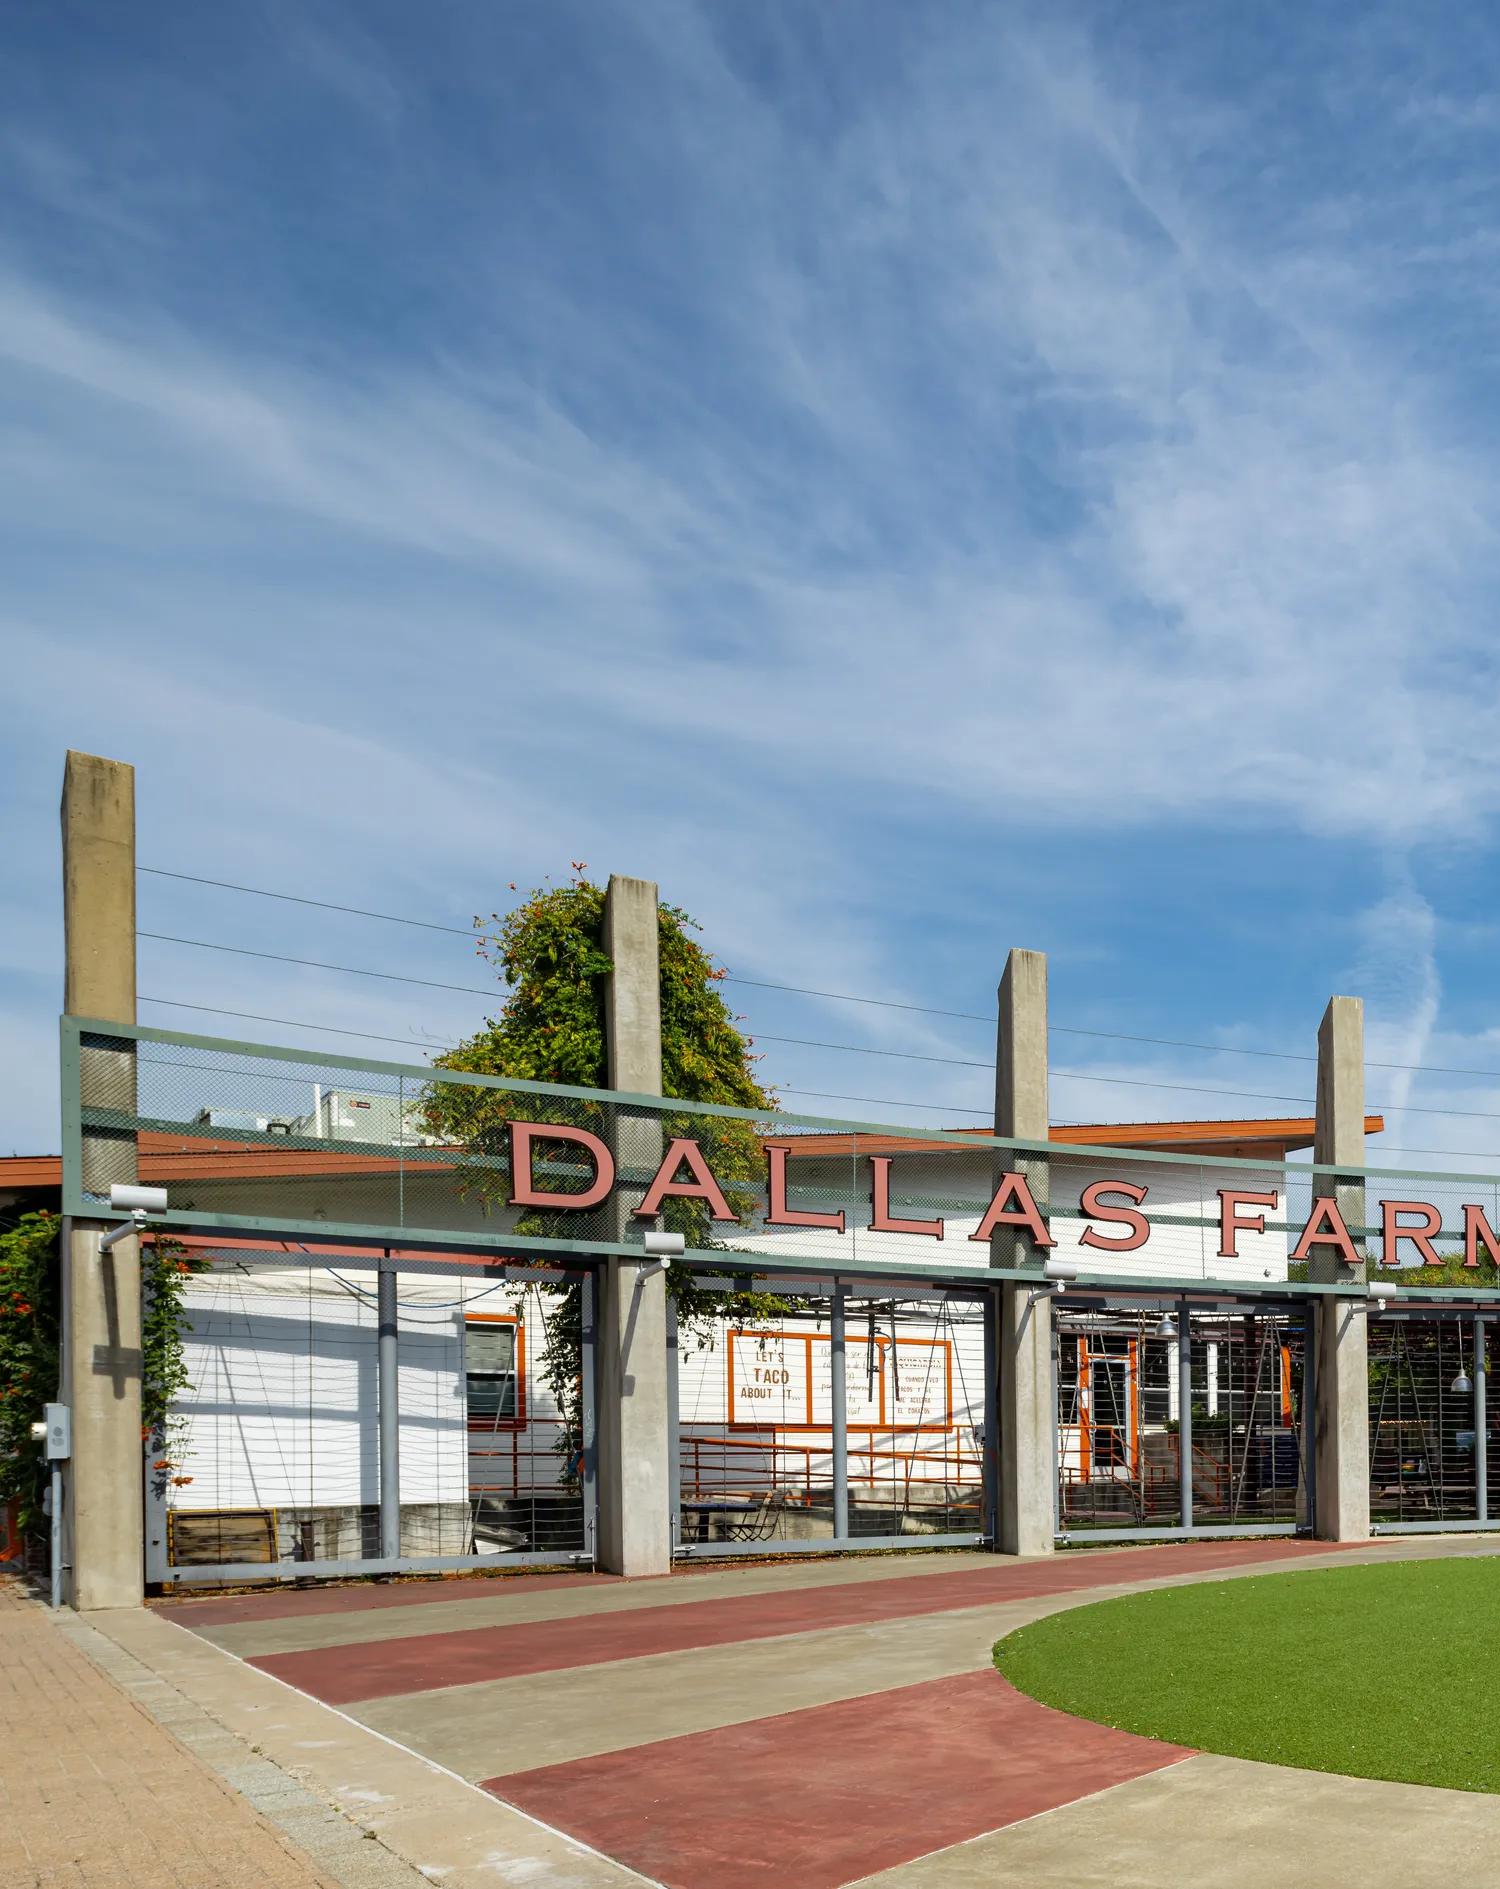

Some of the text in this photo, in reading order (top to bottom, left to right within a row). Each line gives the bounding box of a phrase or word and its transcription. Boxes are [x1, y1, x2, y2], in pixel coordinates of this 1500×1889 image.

[505, 1120, 1151, 1252] DALLAS
[756, 1349, 784, 1362] LET'S
[888, 1358, 942, 1369] TQUICARDIA
[754, 1368, 790, 1385] TACO
[740, 1387, 772, 1399] ABOUT
